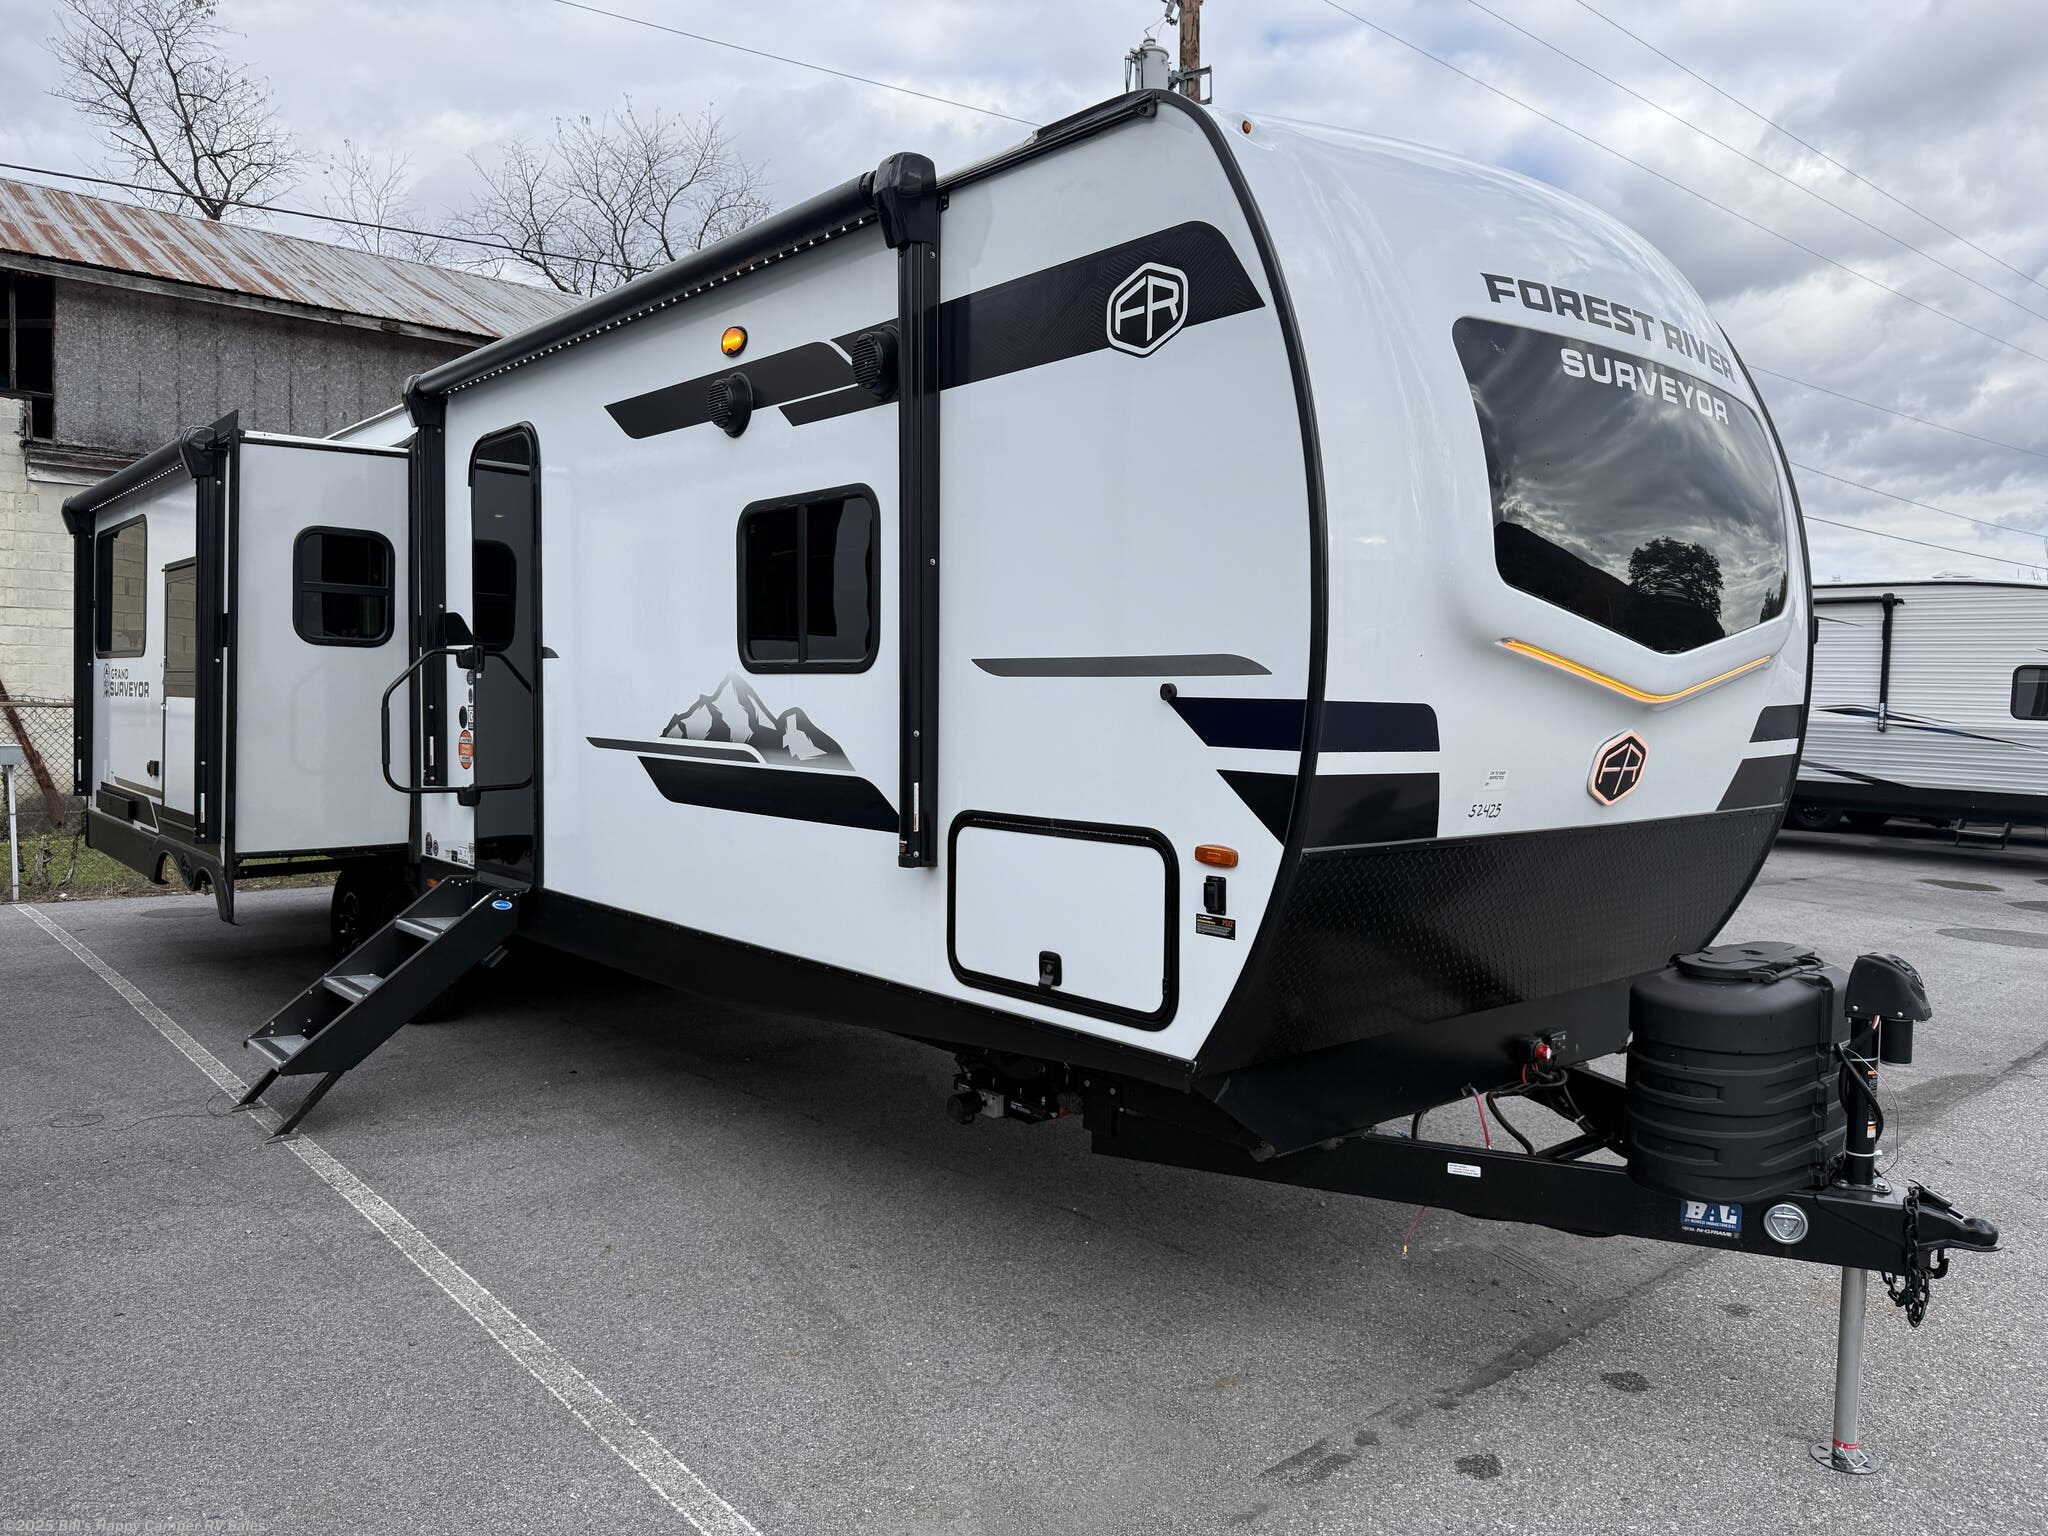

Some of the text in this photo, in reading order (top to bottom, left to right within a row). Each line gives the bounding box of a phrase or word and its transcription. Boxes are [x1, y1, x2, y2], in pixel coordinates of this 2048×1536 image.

[1480, 272, 1737, 385] FOREST RIVER
[1560, 348, 1729, 425] SURVEYOR
[110, 668, 129, 679] GRAND
[109, 681, 150, 698] SURVEYOR
[1467, 803, 1502, 818] 52425
